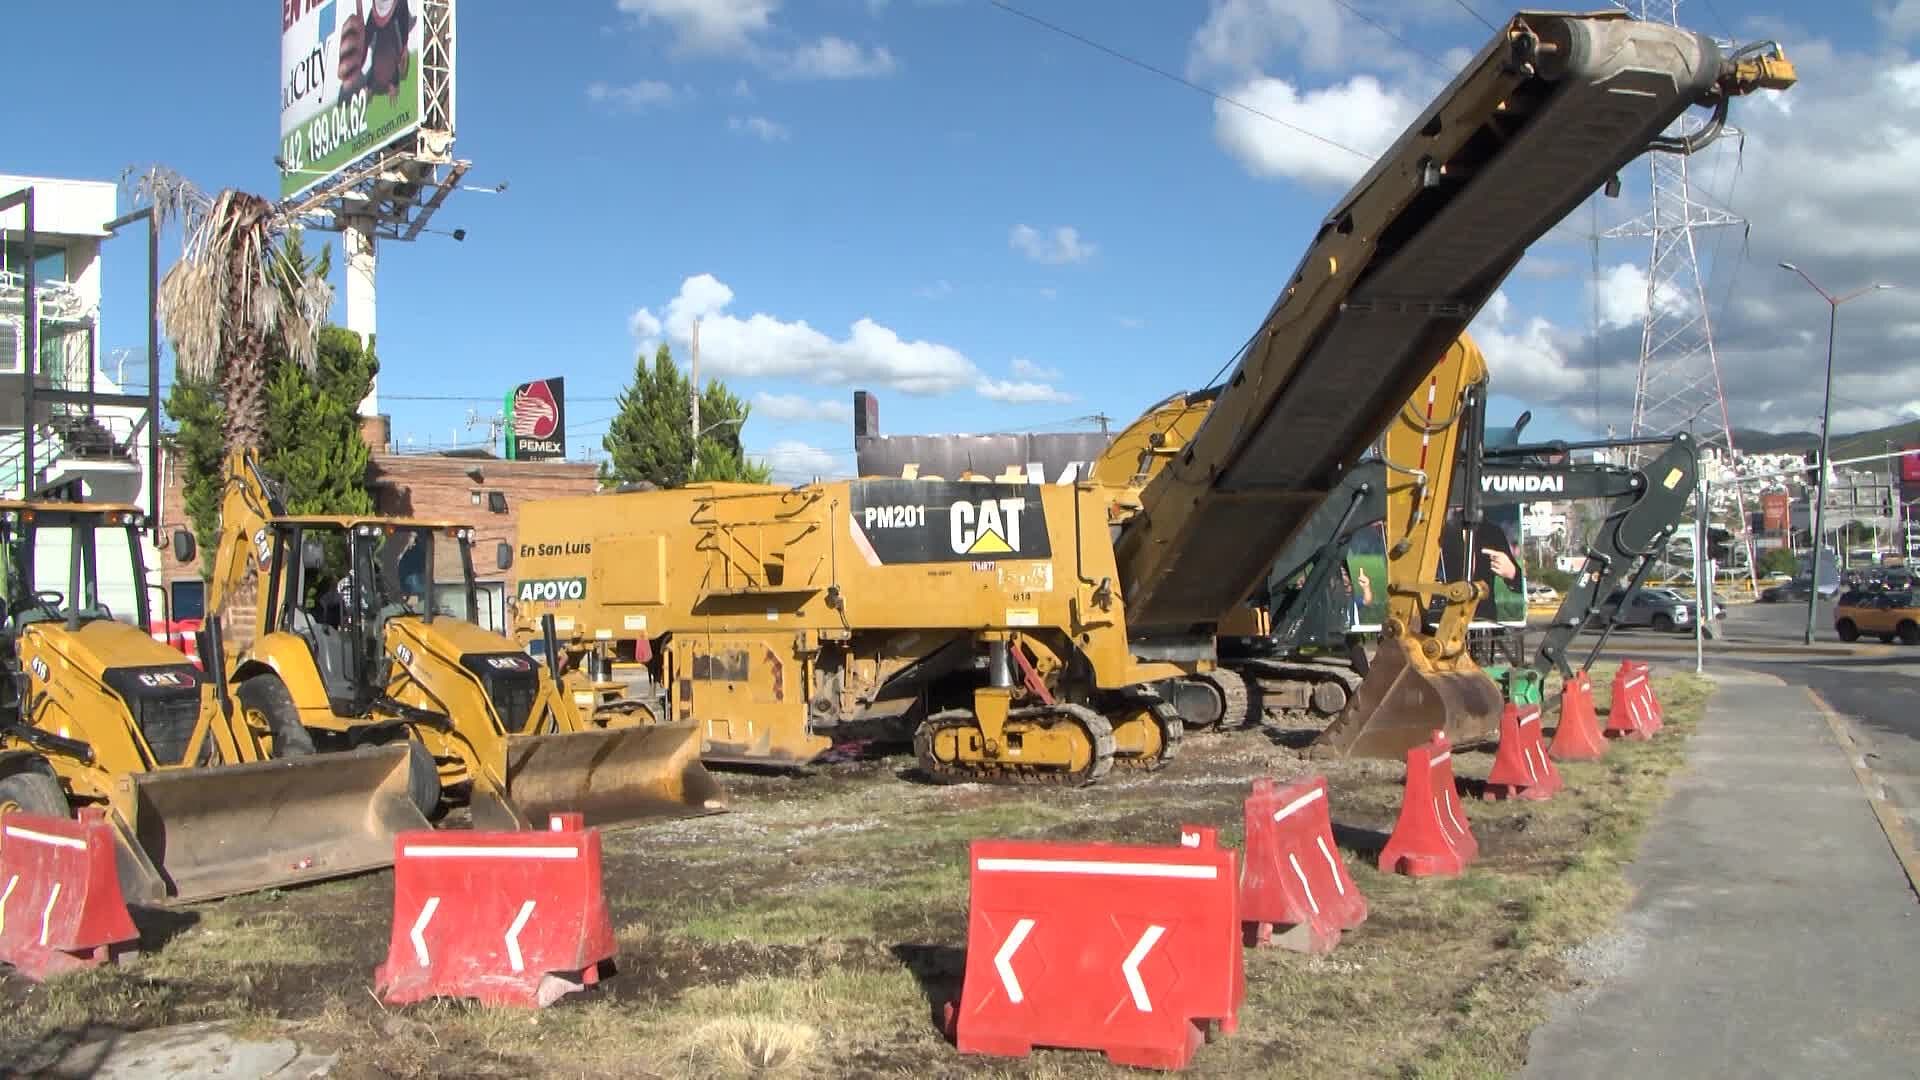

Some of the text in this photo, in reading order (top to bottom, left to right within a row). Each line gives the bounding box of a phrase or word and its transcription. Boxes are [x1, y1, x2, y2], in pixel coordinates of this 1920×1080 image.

[309, 88, 368, 162] 199.04.62
[519, 440, 561, 453] PEMEX
[1481, 475, 1564, 492] YUNDAI
[864, 498, 1025, 554] PM201 CAT
[520, 544, 534, 557] En
[538, 543, 562, 557] San
[521, 580, 582, 601] APOYO
[139, 672, 181, 687] CAT
